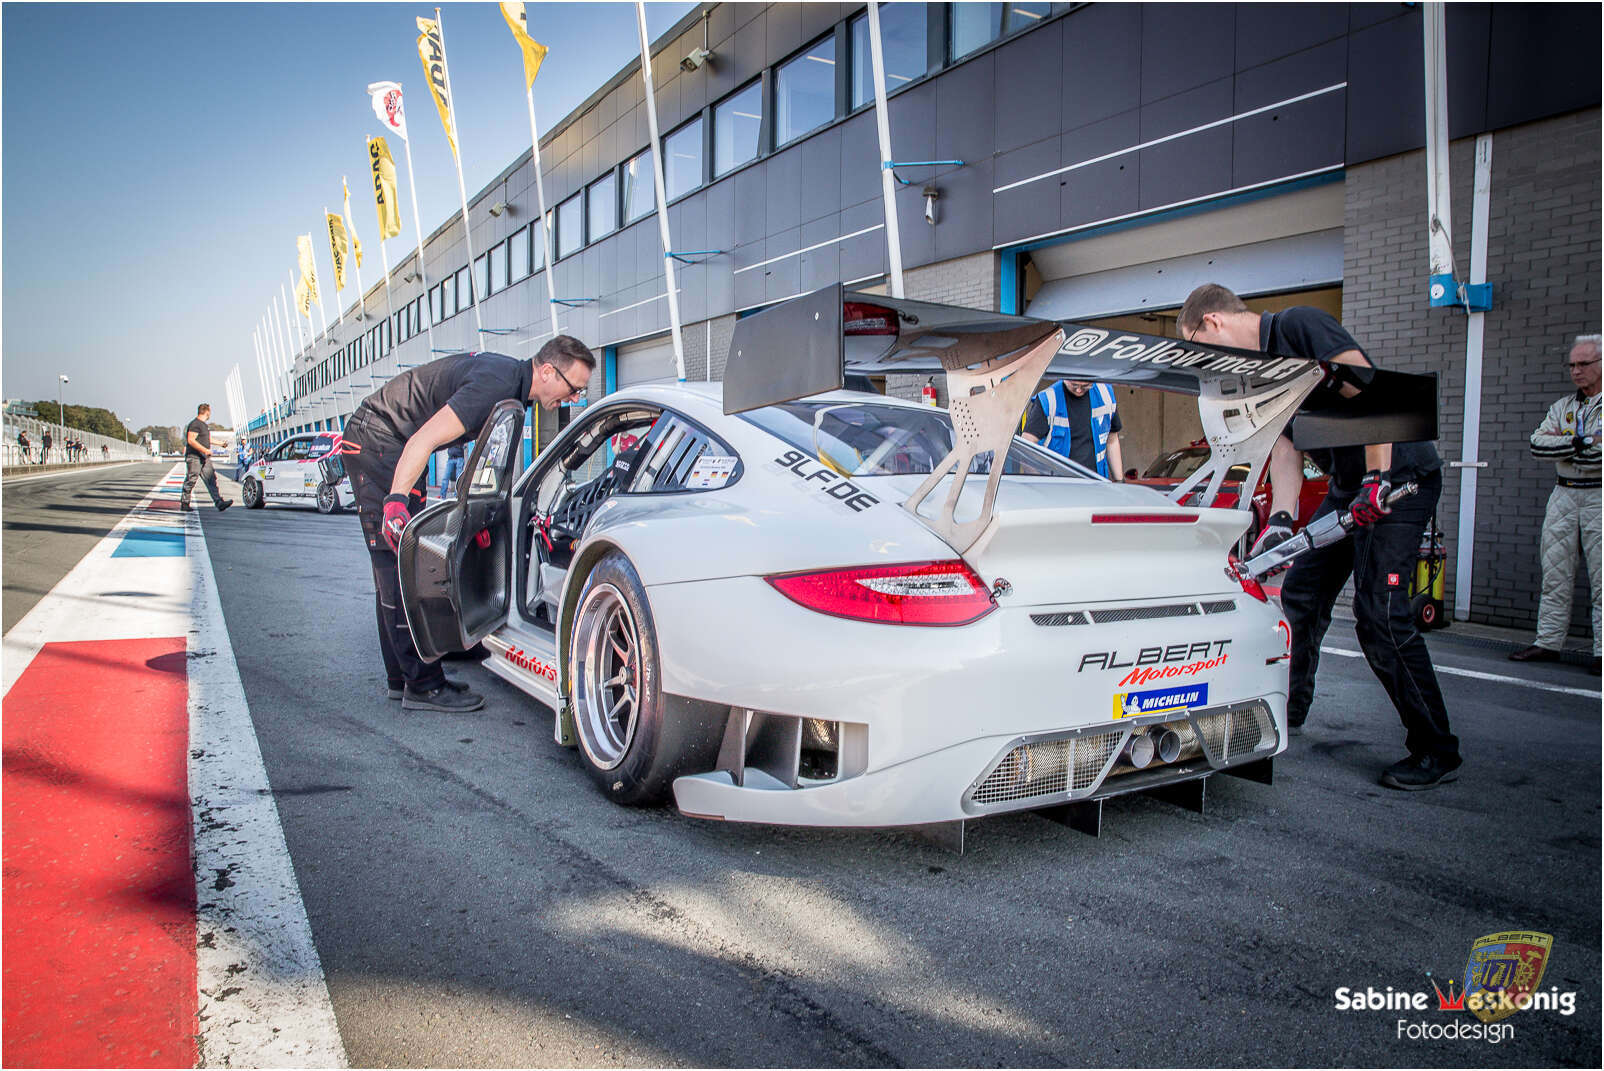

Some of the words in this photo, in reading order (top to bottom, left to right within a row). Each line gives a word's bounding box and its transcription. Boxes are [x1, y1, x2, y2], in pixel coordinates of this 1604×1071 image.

[1090, 335, 1215, 367] Follow
[1201, 356, 1284, 376] me!
[774, 450, 880, 512] 9LF.DE
[1078, 639, 1232, 672] ALBERT
[1118, 653, 1229, 687] Motorsport
[1142, 690, 1199, 709] MICHELIN
